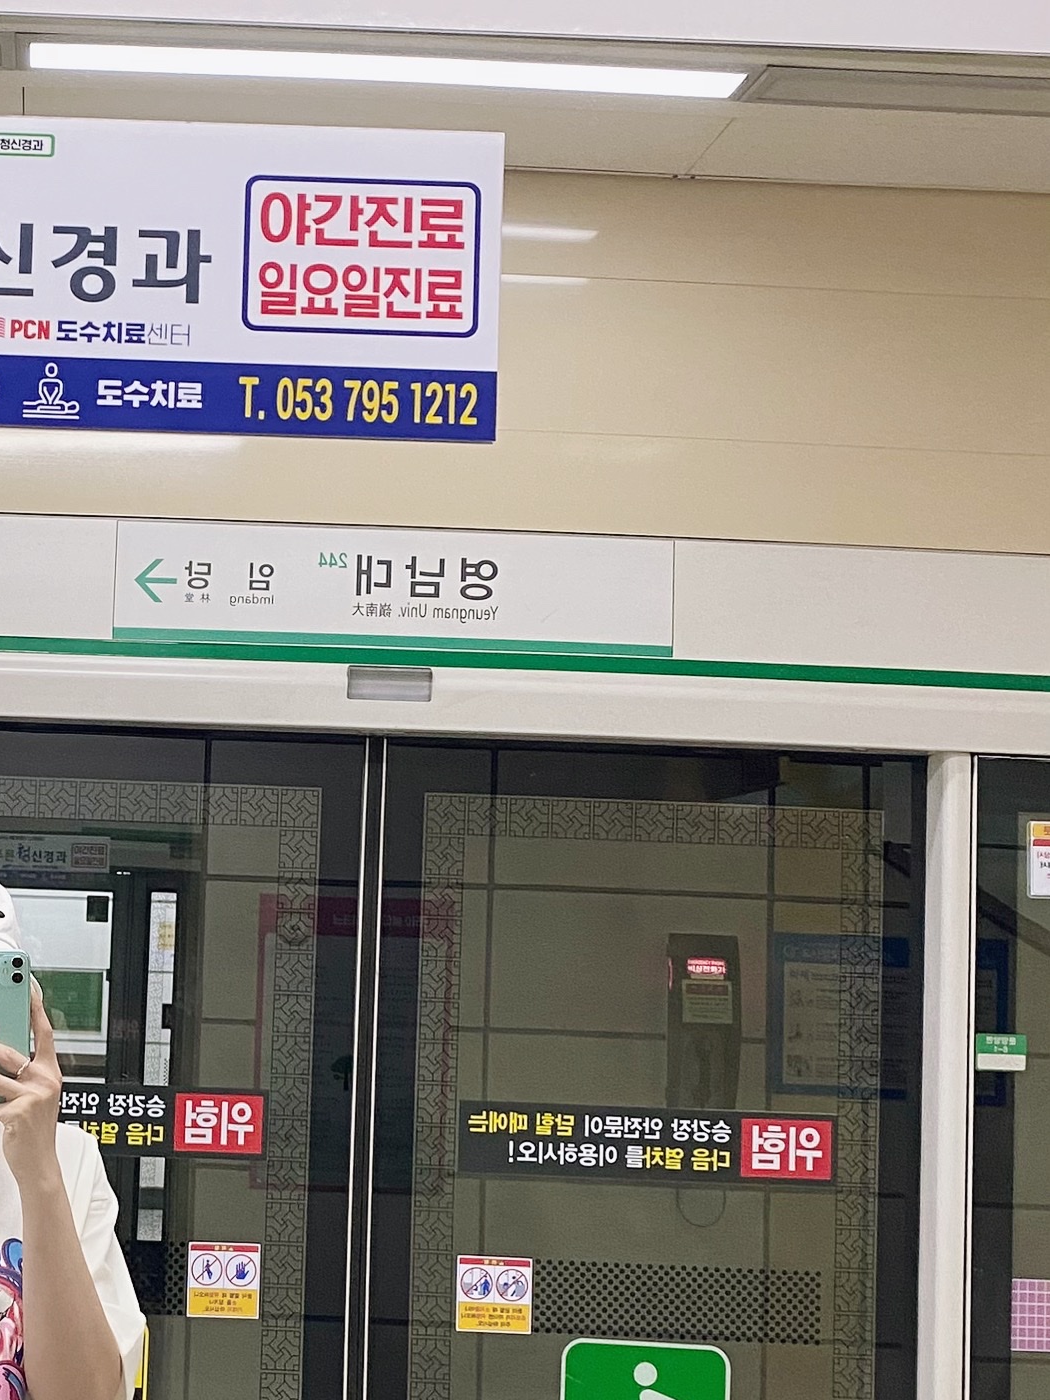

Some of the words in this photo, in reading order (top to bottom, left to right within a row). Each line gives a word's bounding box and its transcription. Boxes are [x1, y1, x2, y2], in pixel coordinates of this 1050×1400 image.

[260, 191, 466, 250] 야간진료
[258, 260, 464, 320] 일요일진료
[10, 319, 50, 340] PCN
[96, 378, 203, 410] 도수치료
[239, 375, 265, 421] T.
[276, 377, 333, 422] 053
[345, 379, 399, 424] 795
[410, 381, 478, 426] 1212
